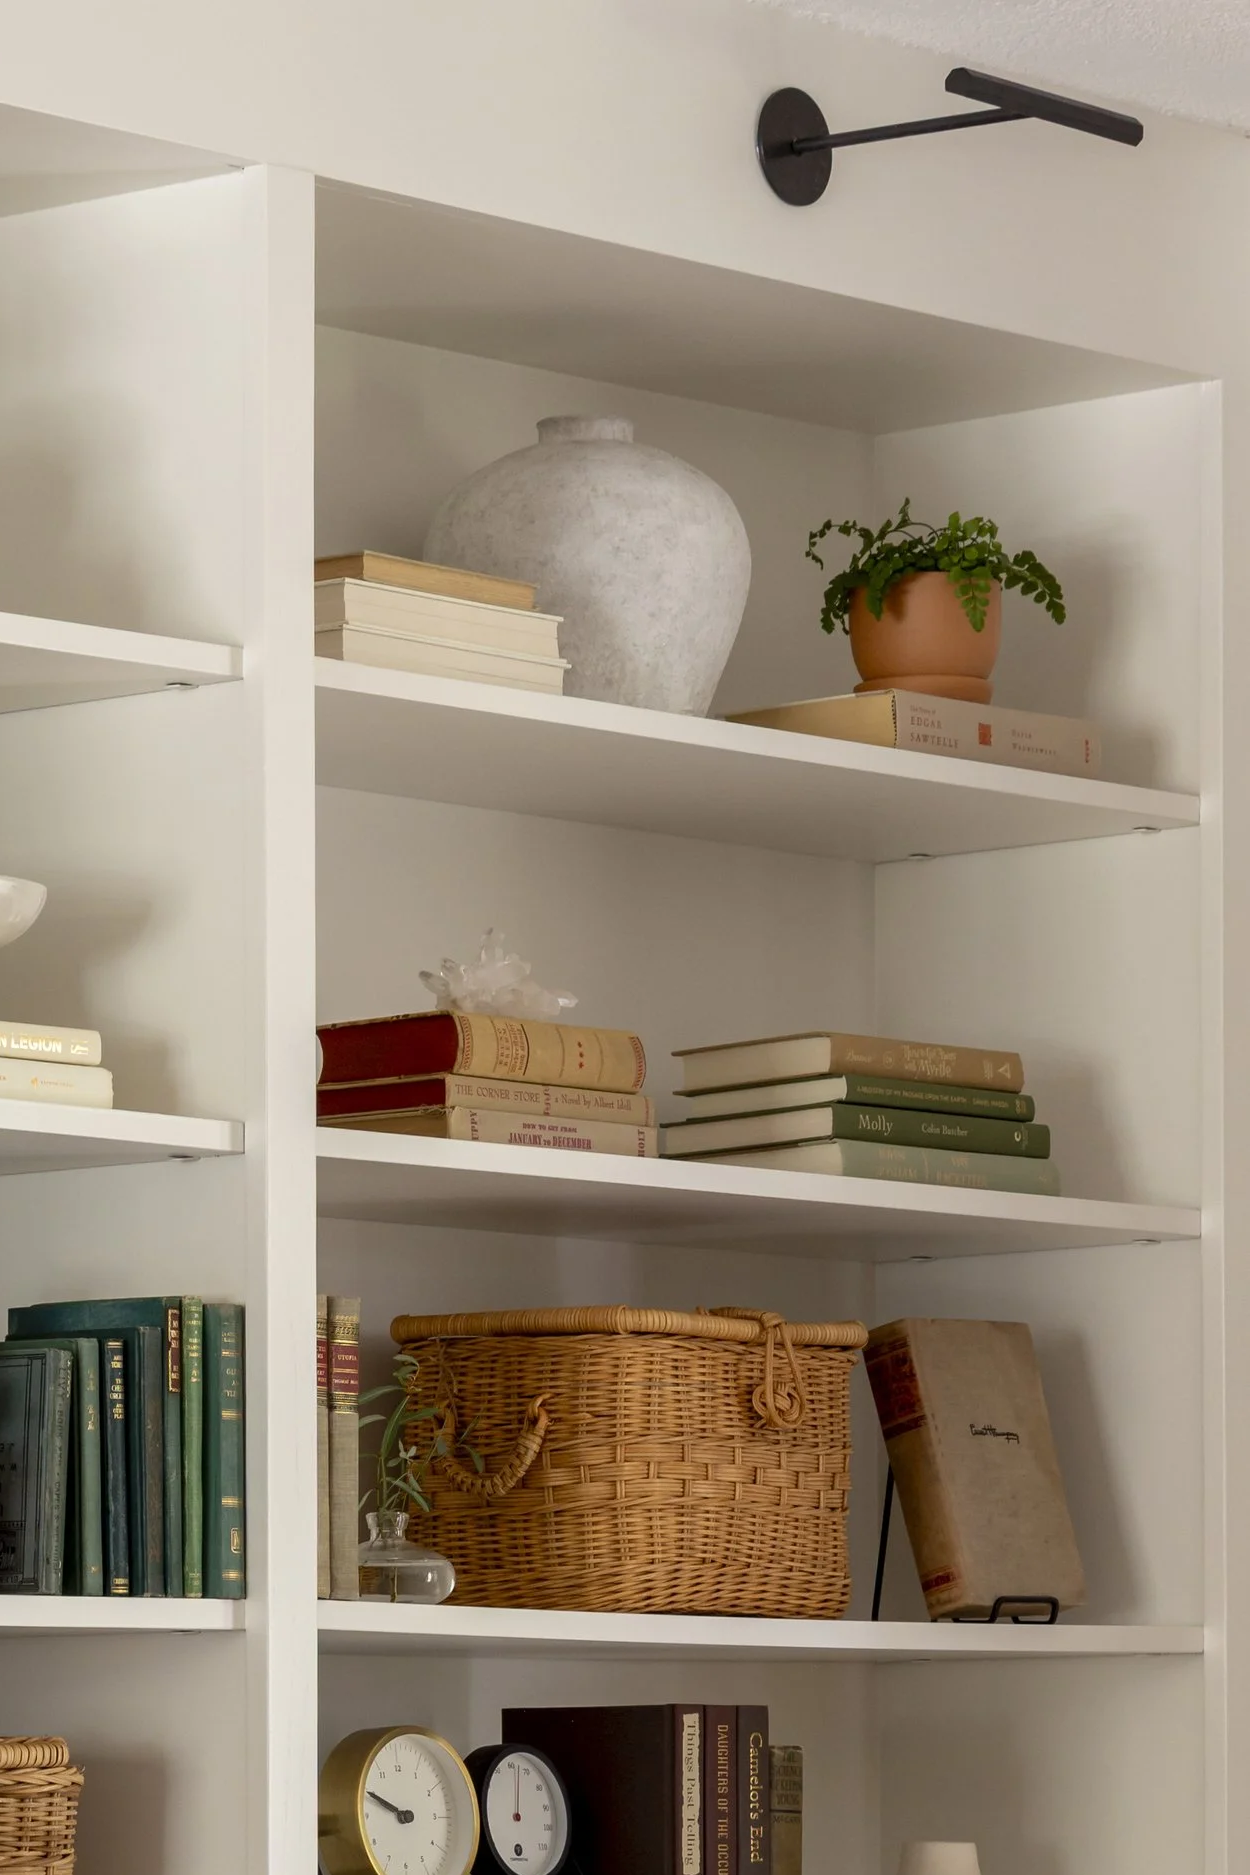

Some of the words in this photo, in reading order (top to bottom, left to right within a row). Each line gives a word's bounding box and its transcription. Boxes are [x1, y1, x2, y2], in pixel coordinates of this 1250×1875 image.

[910, 716, 943, 730] EDGAR
[910, 732, 960, 750] SAWTELLE
[10, 1031, 62, 1053] LEGION
[455, 1084, 473, 1097] THE
[477, 1088, 510, 1100] CORNER
[514, 1091, 541, 1104] STORE
[583, 1094, 591, 1109] by
[469, 1109, 479, 1141] UPPY
[858, 1114, 893, 1136] Molly
[921, 1122, 940, 1135] Colin
[508, 1132, 542, 1146] JANUARY
[552, 1136, 592, 1150] DECEMBER
[684, 1720, 697, 1772] Things
[507, 1761, 515, 1770] 60
[717, 1724, 728, 1794] DAUGHTERS
[379, 1771, 386, 1779] 11
[522, 1768, 530, 1776] 70
[749, 1731, 763, 1820] Camelot's
[536, 1784, 543, 1792] 80
[685, 1777, 696, 1808] Past
[542, 1804, 550, 1812] 90
[717, 1798, 728, 1813] OF
[543, 1823, 553, 1831] 100
[717, 1818, 729, 1839] THE
[538, 1843, 548, 1851] 110
[684, 1813, 697, 1866] Telling
[749, 1825, 763, 1863] End
